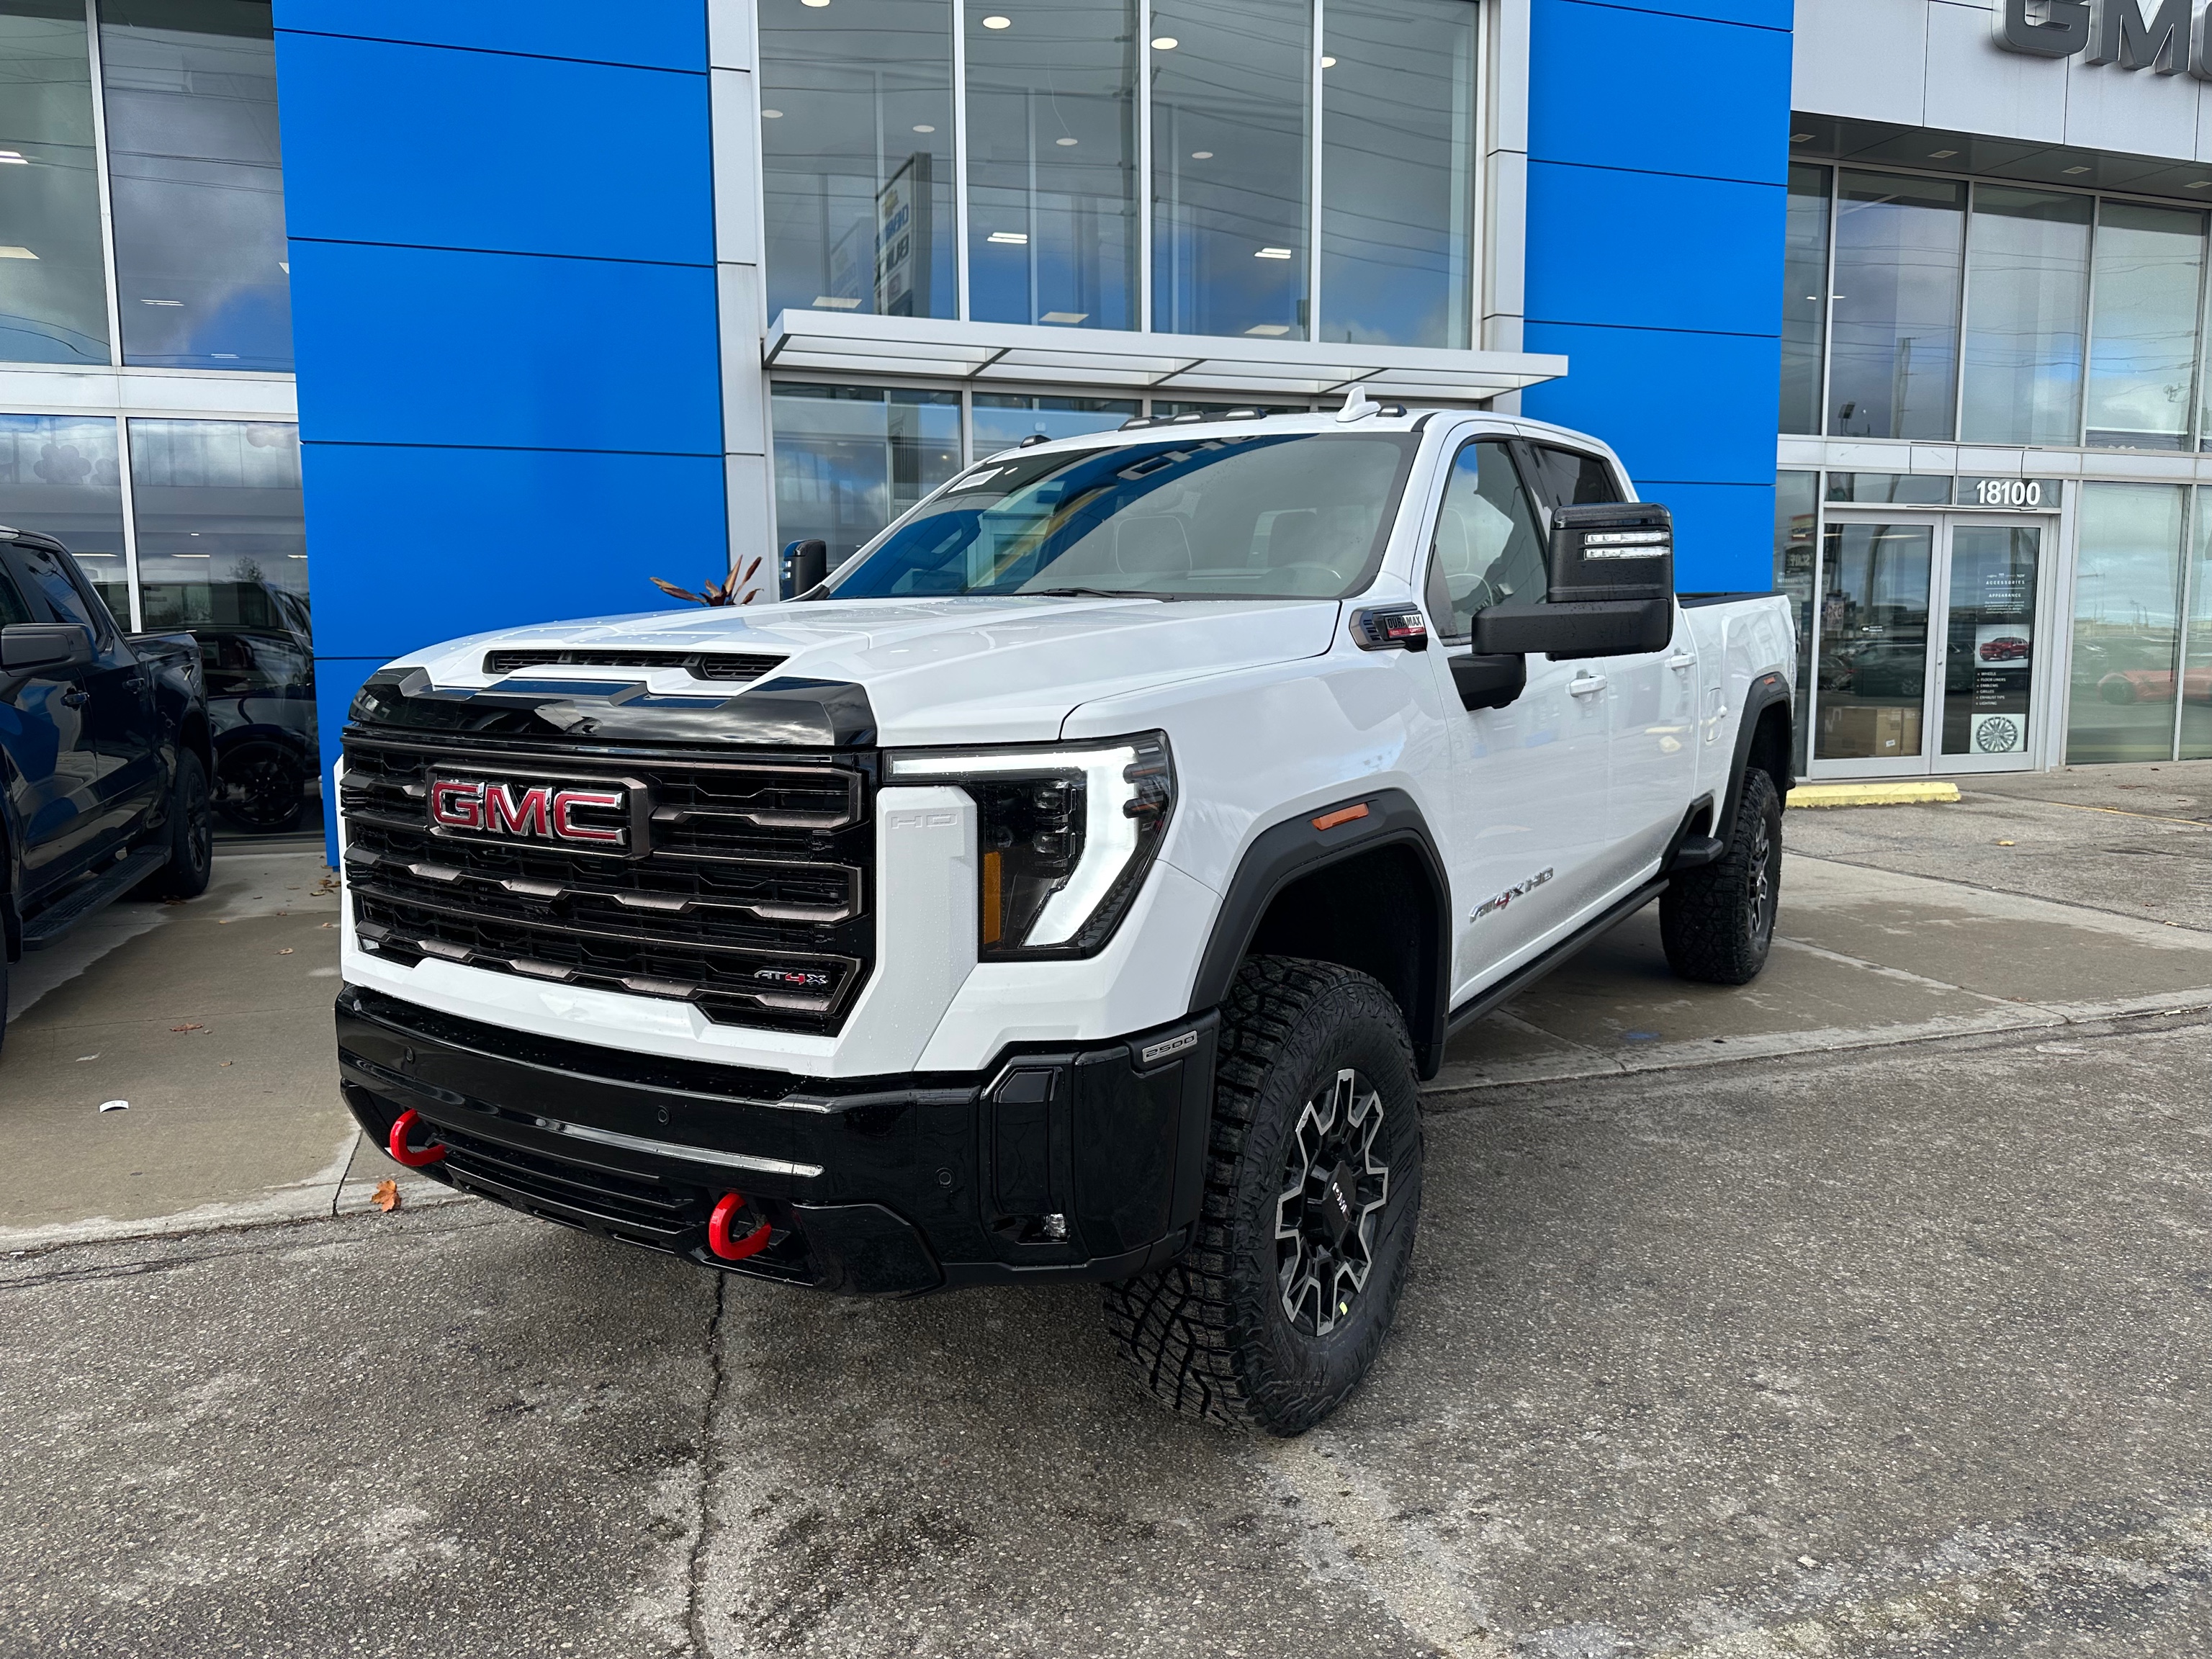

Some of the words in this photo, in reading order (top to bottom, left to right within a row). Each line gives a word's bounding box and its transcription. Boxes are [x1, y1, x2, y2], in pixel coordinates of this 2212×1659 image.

[1990, 0, 2212, 81] GM
[1977, 480, 2041, 505] 18100
[1387, 614, 1423, 629] DURAMAX
[432, 778, 627, 845] GMC
[891, 813, 958, 830] HD
[754, 969, 830, 986] AT4X
[1146, 1034, 1195, 1058] 2500
